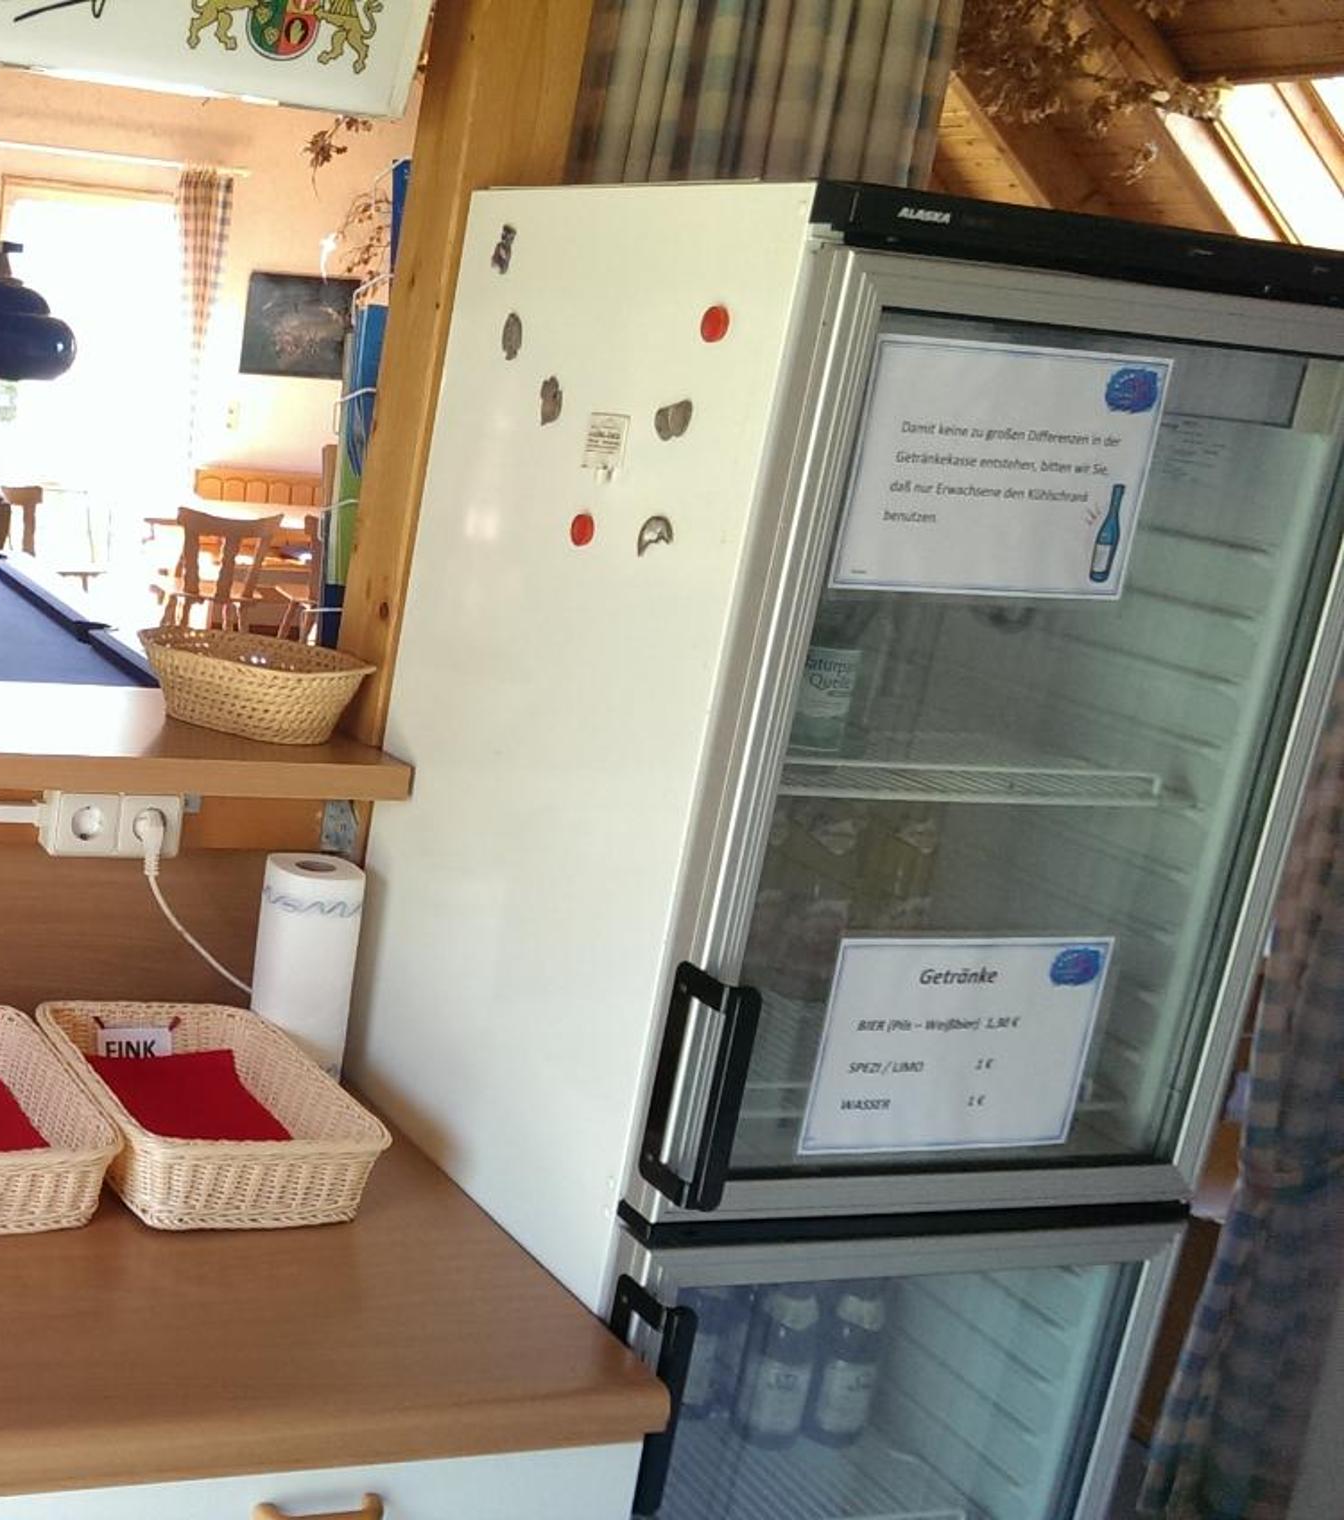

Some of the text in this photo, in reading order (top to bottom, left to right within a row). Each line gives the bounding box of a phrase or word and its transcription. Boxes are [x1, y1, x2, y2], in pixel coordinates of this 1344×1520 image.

[896, 206, 951, 224] ALASKA
[901, 420, 1122, 447] Damit keine zu großen Differenzen in der
[896, 450, 977, 467] Getränkekasse
[1040, 460, 1072, 473] bitten
[1075, 463, 1090, 474] wir
[889, 479, 1089, 502] daß nur Erwachsene den Kühlschrank
[919, 966, 999, 985] Getränke
[857, 1019, 886, 1032] BIER
[847, 1061, 882, 1075] SPEZI
[892, 1060, 925, 1074] LIMO
[840, 1098, 891, 1111] WASSER
